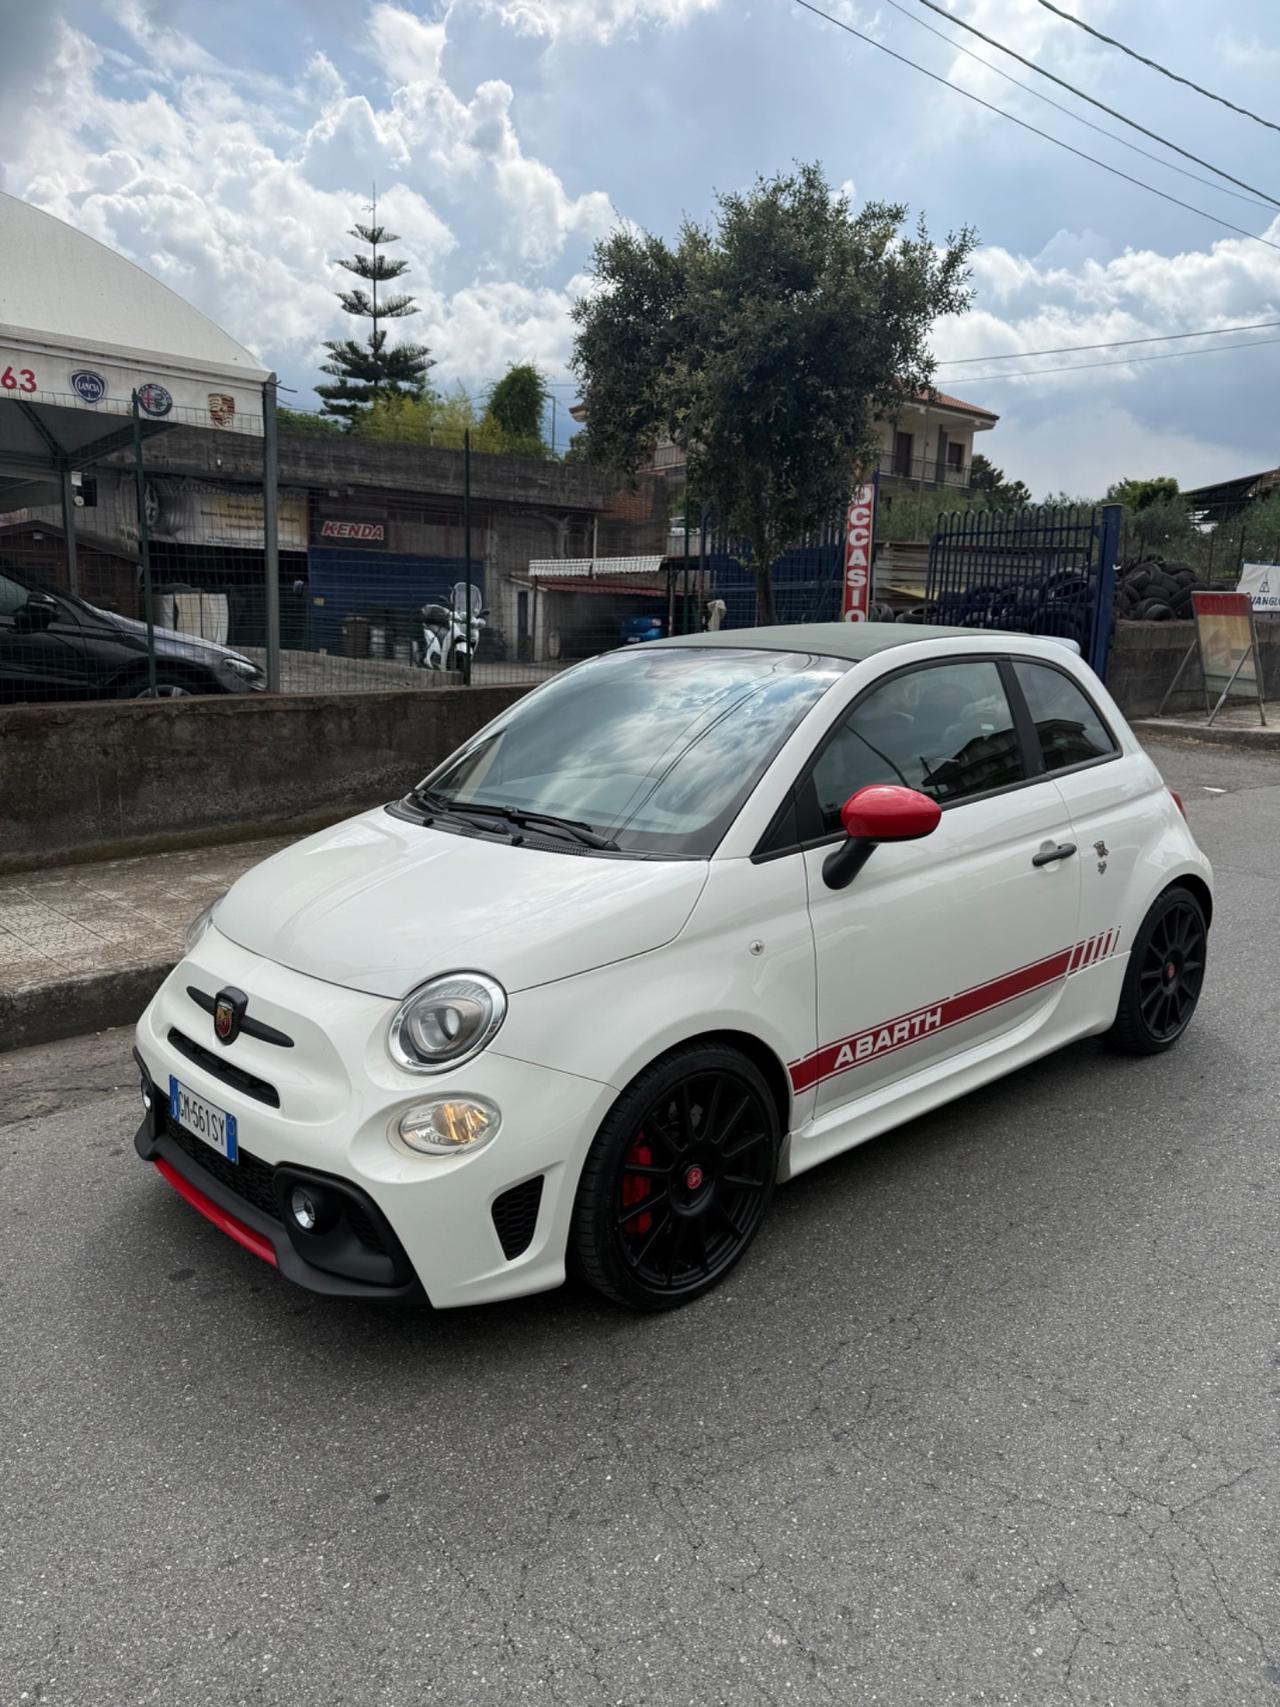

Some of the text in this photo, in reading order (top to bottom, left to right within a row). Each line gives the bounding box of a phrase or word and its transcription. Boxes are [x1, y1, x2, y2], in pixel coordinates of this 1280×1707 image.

[1, 366, 37, 393] 63
[321, 520, 384, 541] KENDA
[834, 1007, 942, 1069] ABARTH
